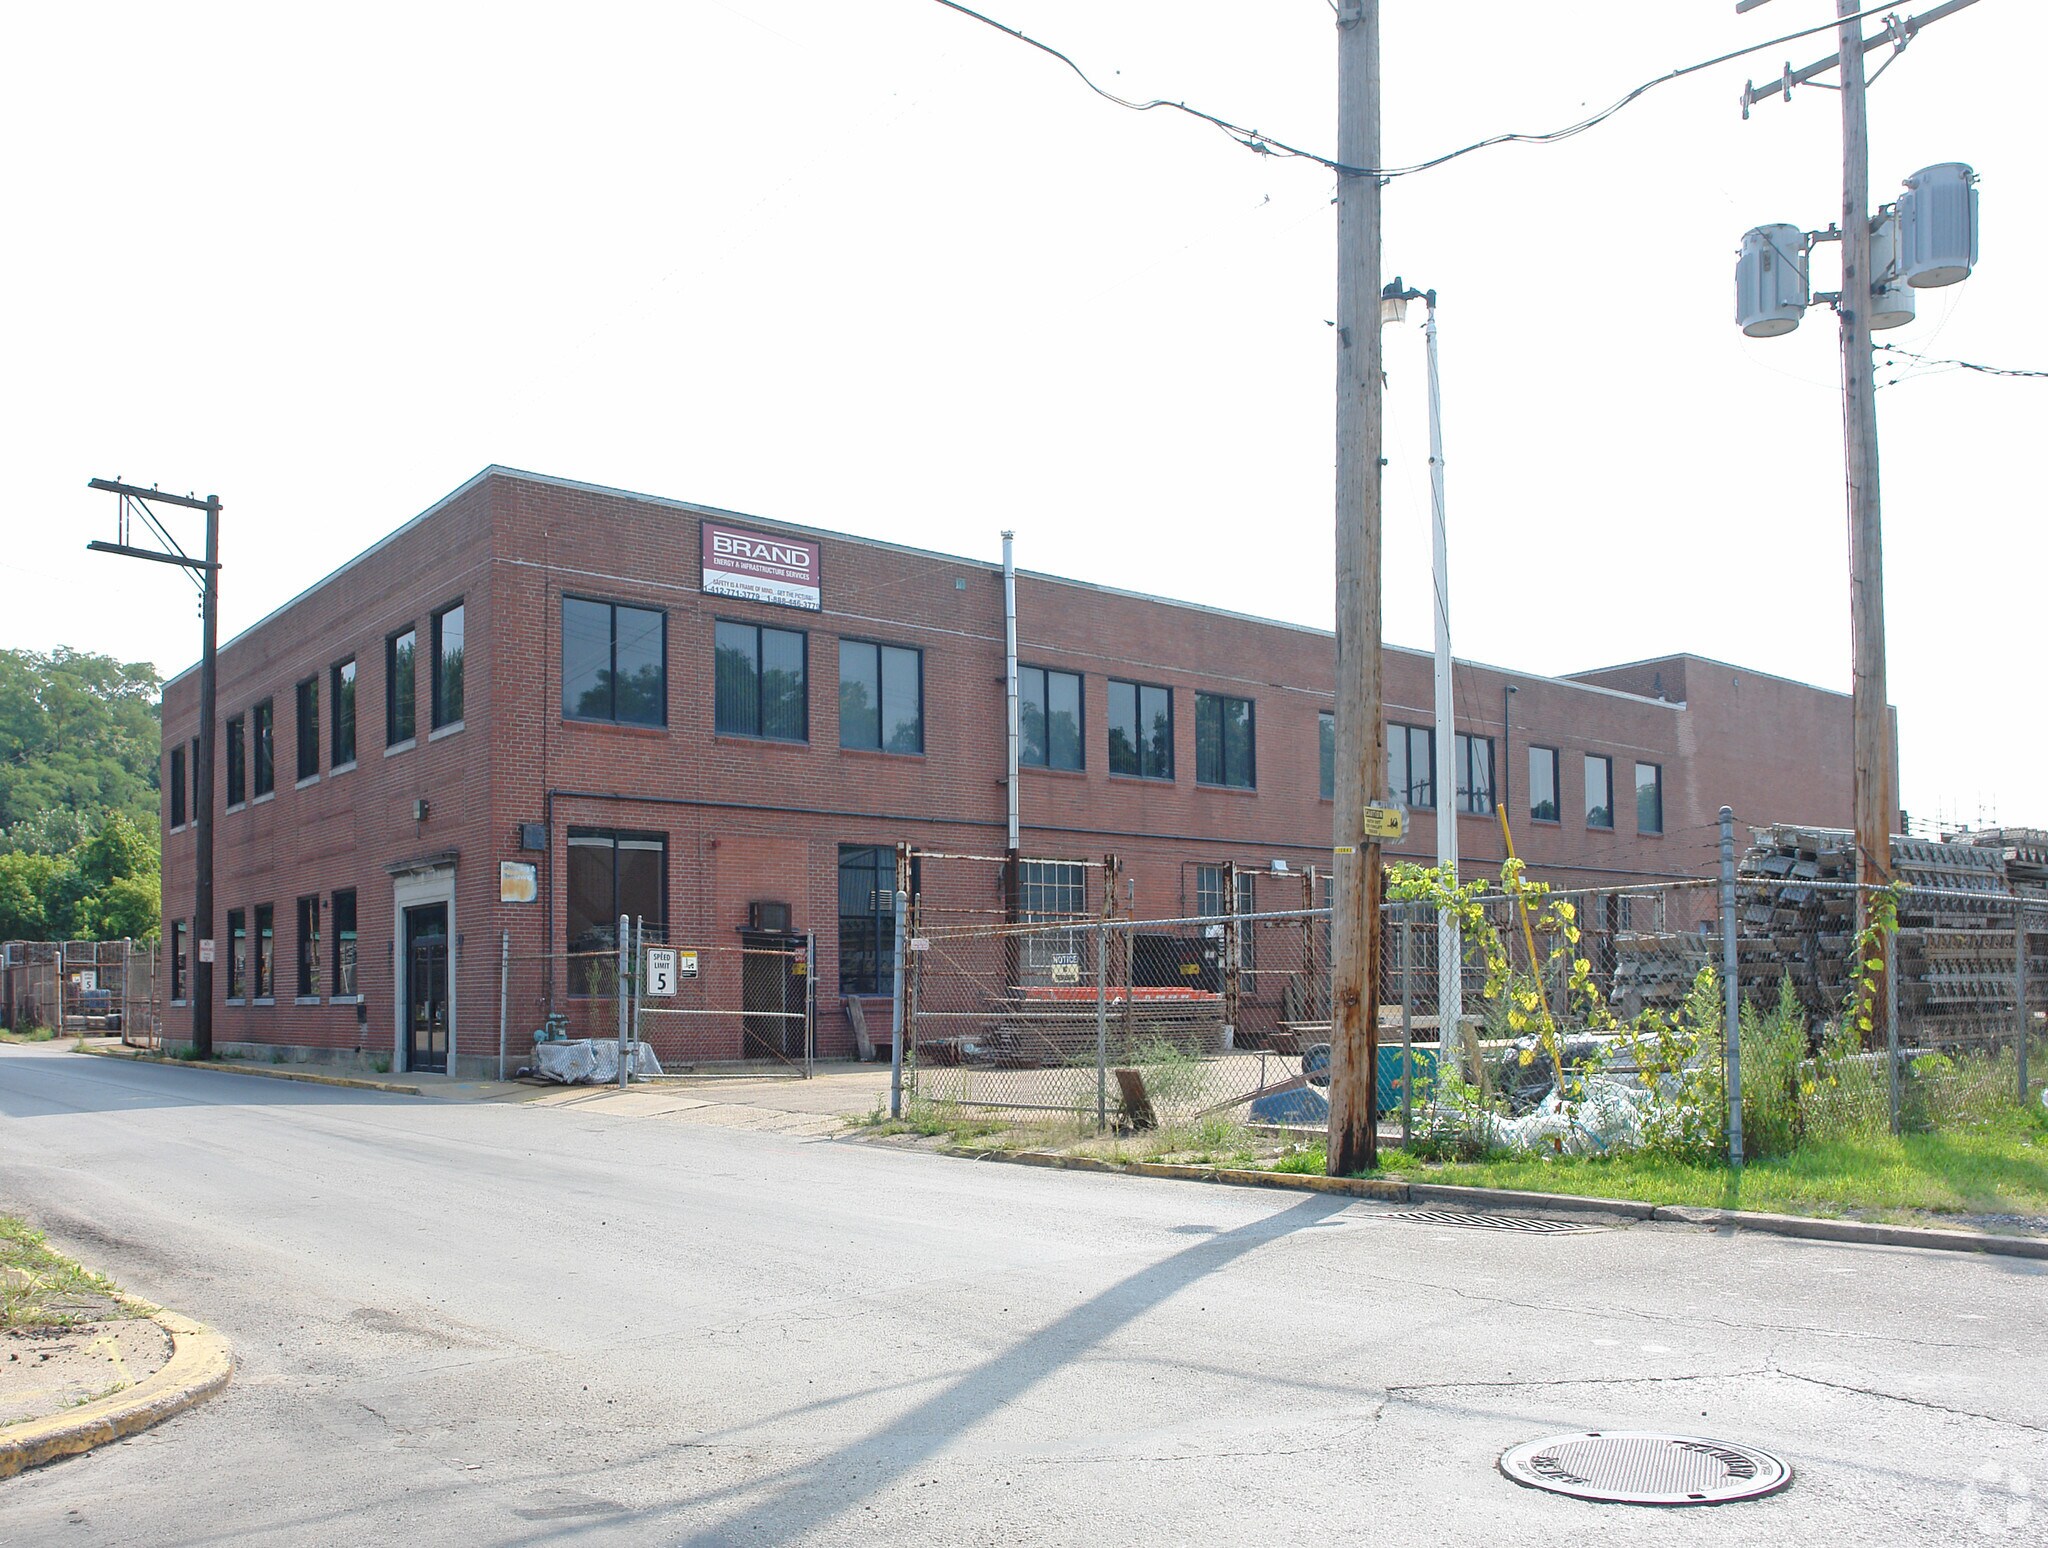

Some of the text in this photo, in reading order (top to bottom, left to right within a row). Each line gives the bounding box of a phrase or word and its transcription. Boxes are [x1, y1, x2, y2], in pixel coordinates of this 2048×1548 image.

[713, 535, 810, 567] BRAND
[714, 557, 735, 568] ENERGY
[740, 562, 785, 576] INFRASTRUCTURE
[786, 570, 809, 580] SERVICES
[653, 953, 671, 961] SPEED
[1053, 955, 1078, 964] NOTICE
[86, 980, 92, 989] 5
[657, 973, 666, 990] 5
[1681, 1442, 1755, 1480] SANITARY
